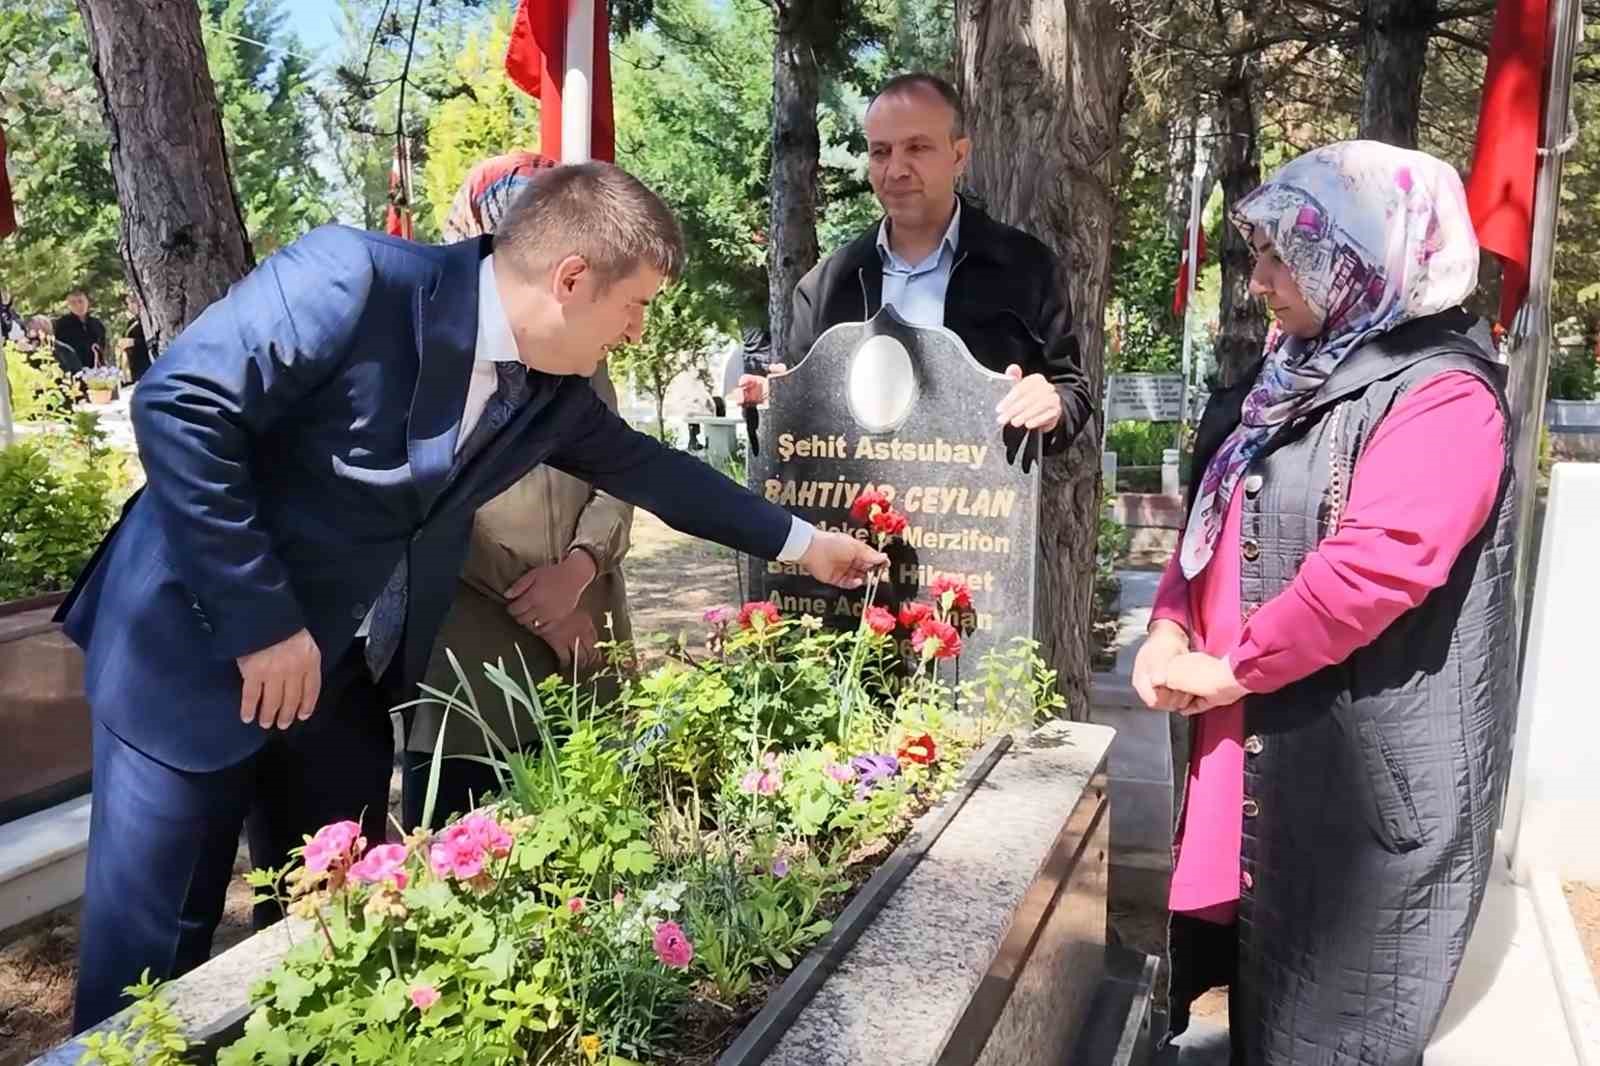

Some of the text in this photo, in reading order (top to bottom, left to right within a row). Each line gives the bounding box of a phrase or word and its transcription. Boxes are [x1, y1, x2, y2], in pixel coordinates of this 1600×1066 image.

[778, 433, 988, 470] Şehit Astsubay
[904, 485, 1017, 518] CEYLAN
[902, 525, 1010, 553] Merzifon
[768, 589, 827, 615] Anne
